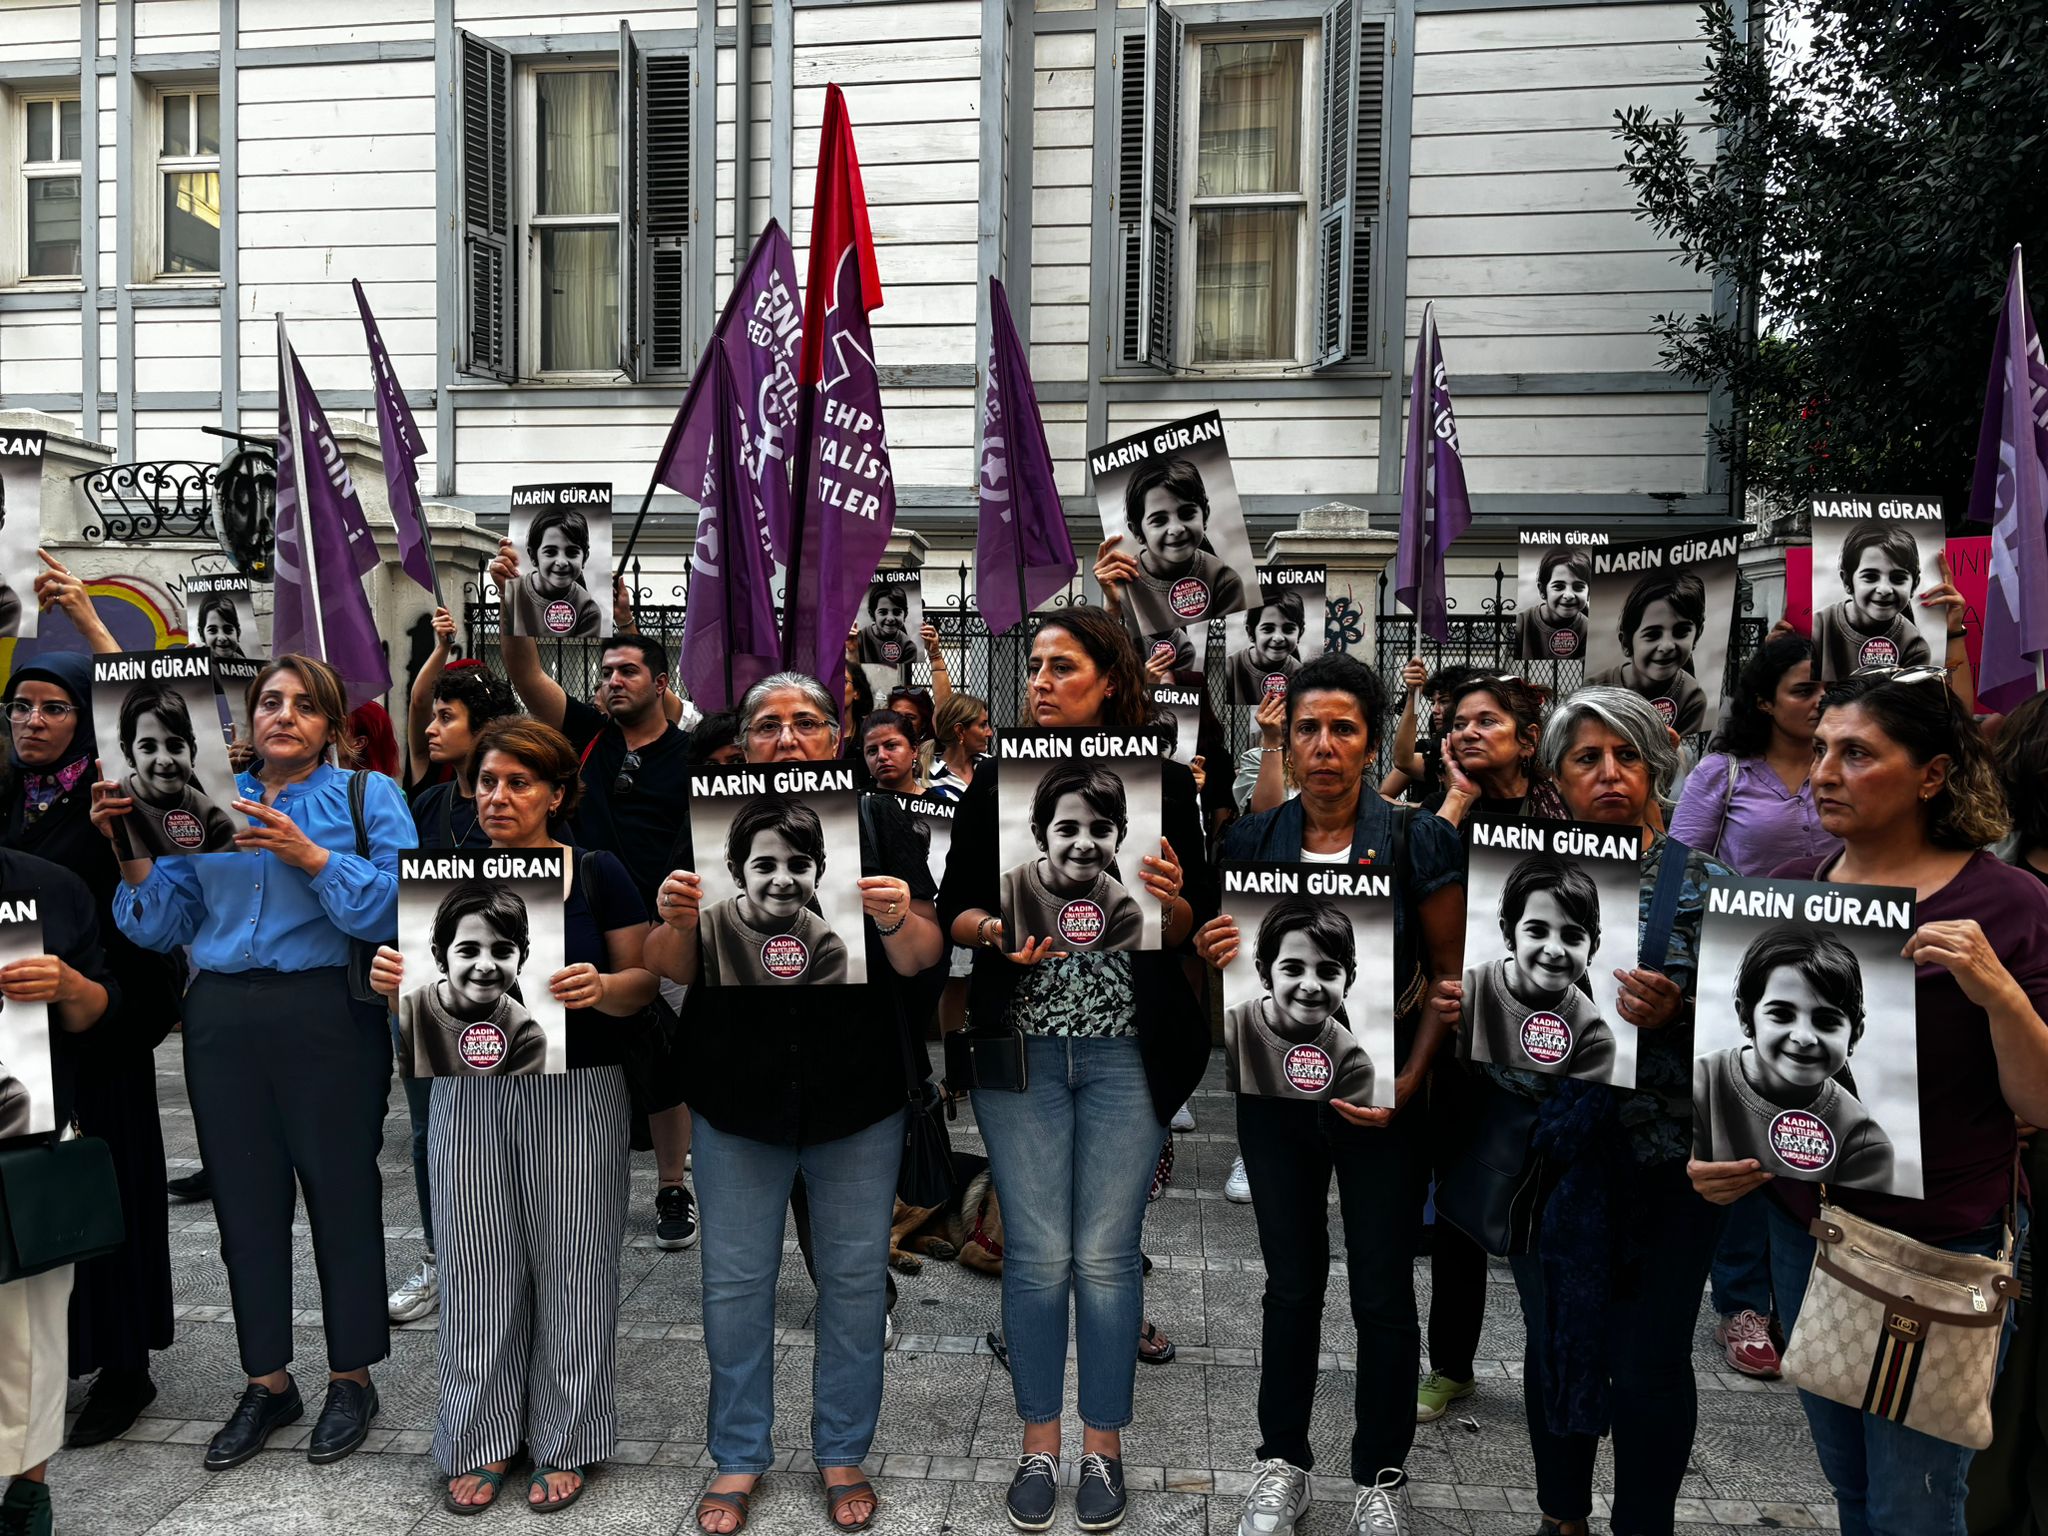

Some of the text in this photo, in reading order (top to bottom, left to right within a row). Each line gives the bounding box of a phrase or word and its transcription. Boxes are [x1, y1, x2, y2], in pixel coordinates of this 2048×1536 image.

[0, 437, 42, 457] RAN
[1092, 419, 1221, 475] NARİN GÜRAN
[512, 487, 610, 505] NARİN GÜRAN
[1812, 499, 1942, 520] NARİN GÜRAN
[1520, 530, 1609, 545] NARİN GÜRAN
[1595, 536, 1738, 574] NARİN GÜRAN
[187, 578, 211, 593] NARİN
[214, 577, 248, 591] GÜRAN
[886, 571, 919, 583] GÜRAN
[1276, 569, 1324, 584] GÜRAN
[94, 655, 210, 682] NARİN GÜRAN
[1154, 688, 1199, 706] GÜRAN
[1001, 733, 1158, 759] NARİN GÜRAN
[691, 768, 853, 797] NARİN GÜRAN
[910, 799, 955, 818] GÜRAN
[1472, 822, 1638, 861] NARİN GÜRAN
[401, 854, 561, 880] NARİN GÜRAN
[1225, 868, 1391, 897] NARİN GÜRAN
[1709, 886, 1909, 930] NARİN GÜRAN
[1533, 1017, 1560, 1027] KADIN
[1294, 1050, 1320, 1058] KADIN
[1783, 1116, 1818, 1129] KADIN
